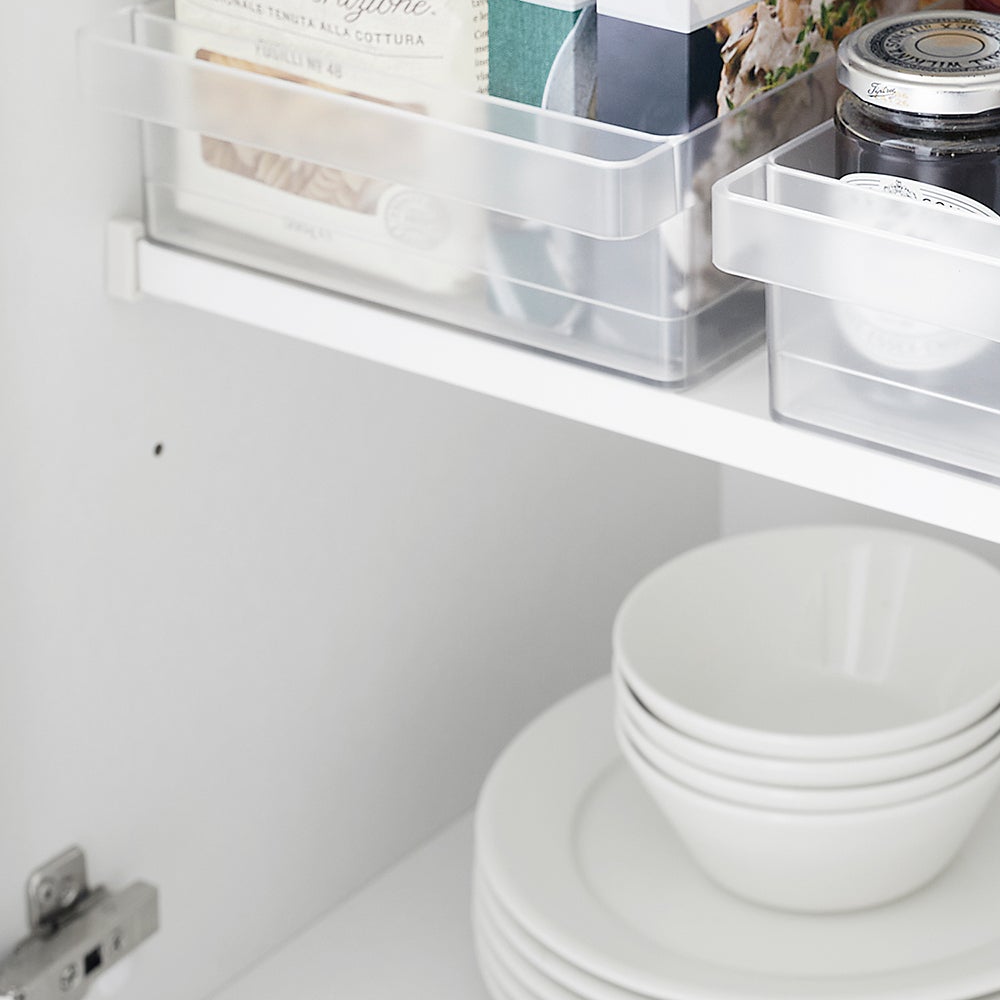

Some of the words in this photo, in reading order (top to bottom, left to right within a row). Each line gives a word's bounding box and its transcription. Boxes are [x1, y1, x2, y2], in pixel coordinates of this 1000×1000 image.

[267, 7, 315, 30] TENUTA
[319, 22, 351, 39] ALLA
[355, 31, 425, 47] COTTURA
